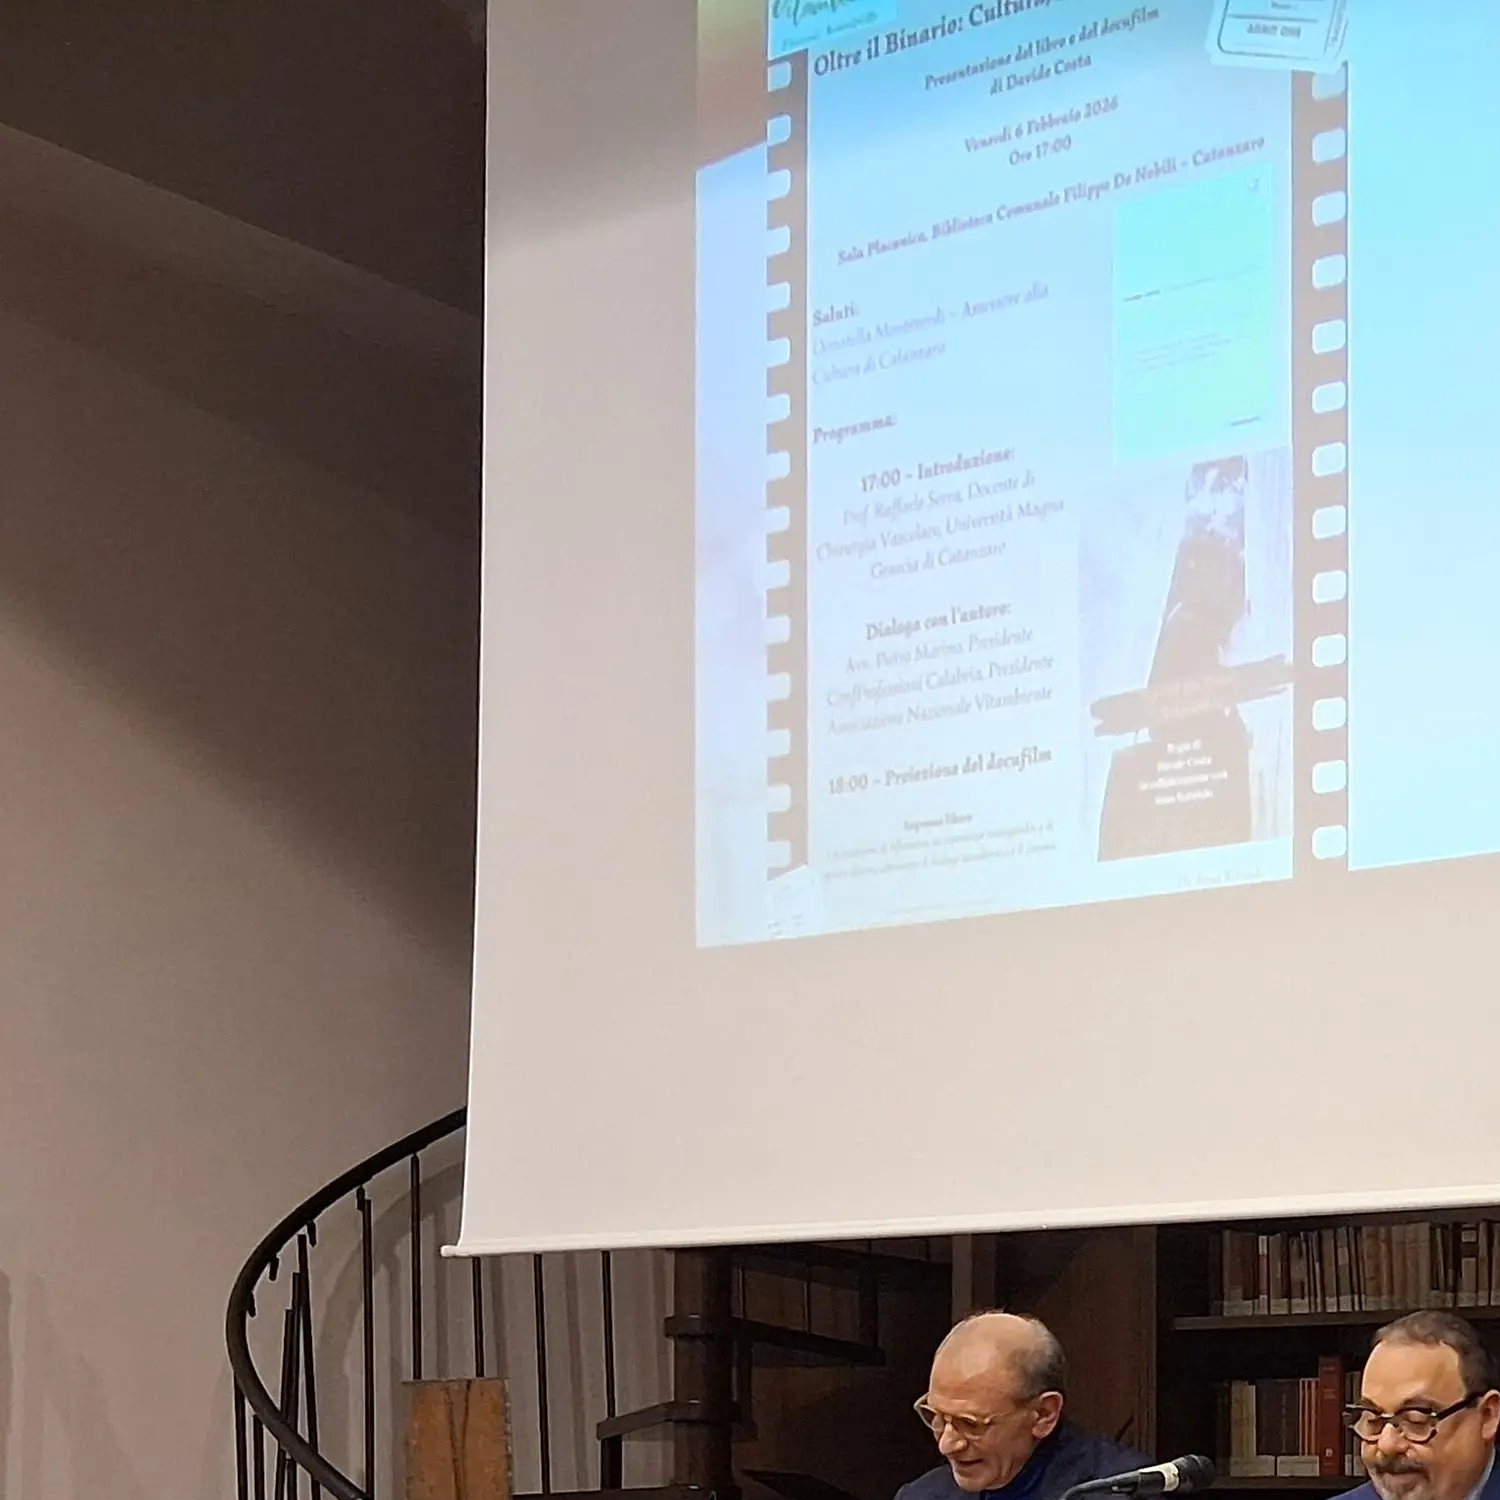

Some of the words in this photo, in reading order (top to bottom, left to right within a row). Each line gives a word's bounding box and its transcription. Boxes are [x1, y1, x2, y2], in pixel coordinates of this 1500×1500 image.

[814, 48, 860, 76] Oltre
[866, 36, 880, 60] il
[884, 16, 963, 56] Binario:
[925, 53, 1012, 90] Presentazione
[1015, 41, 1033, 60] del
[1036, 35, 1064, 56] libro
[1079, 22, 1098, 42] del
[1100, 6, 1160, 36] docufilm
[990, 78, 1003, 97] di
[1006, 62, 1052, 90] Davide
[1054, 53, 1092, 77] Costa
[1014, 125, 1023, 141] 6
[1027, 106, 1081, 135] Febbraio
[1083, 94, 1119, 119] 2026
[1008, 151, 1032, 167] Ore
[1035, 134, 1072, 159] 17:00
[860, 467, 901, 494] 17:00
